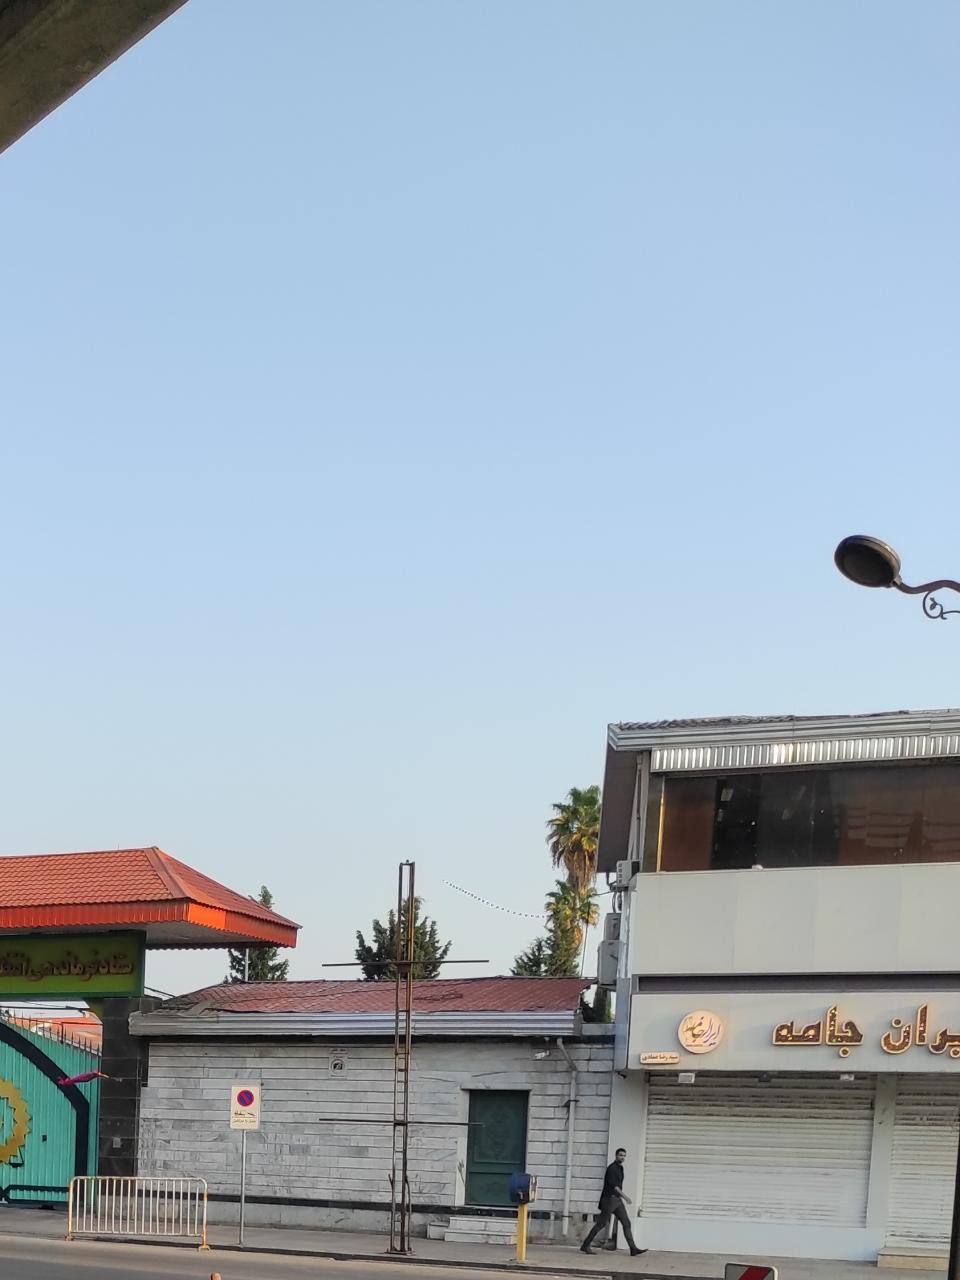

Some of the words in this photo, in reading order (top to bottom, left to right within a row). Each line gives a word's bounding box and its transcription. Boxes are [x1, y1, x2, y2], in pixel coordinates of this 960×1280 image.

[26, 951, 100, 982] فرماندهی
[98, 953, 134, 976] ستاد
[772, 1003, 863, 1058] جامه
